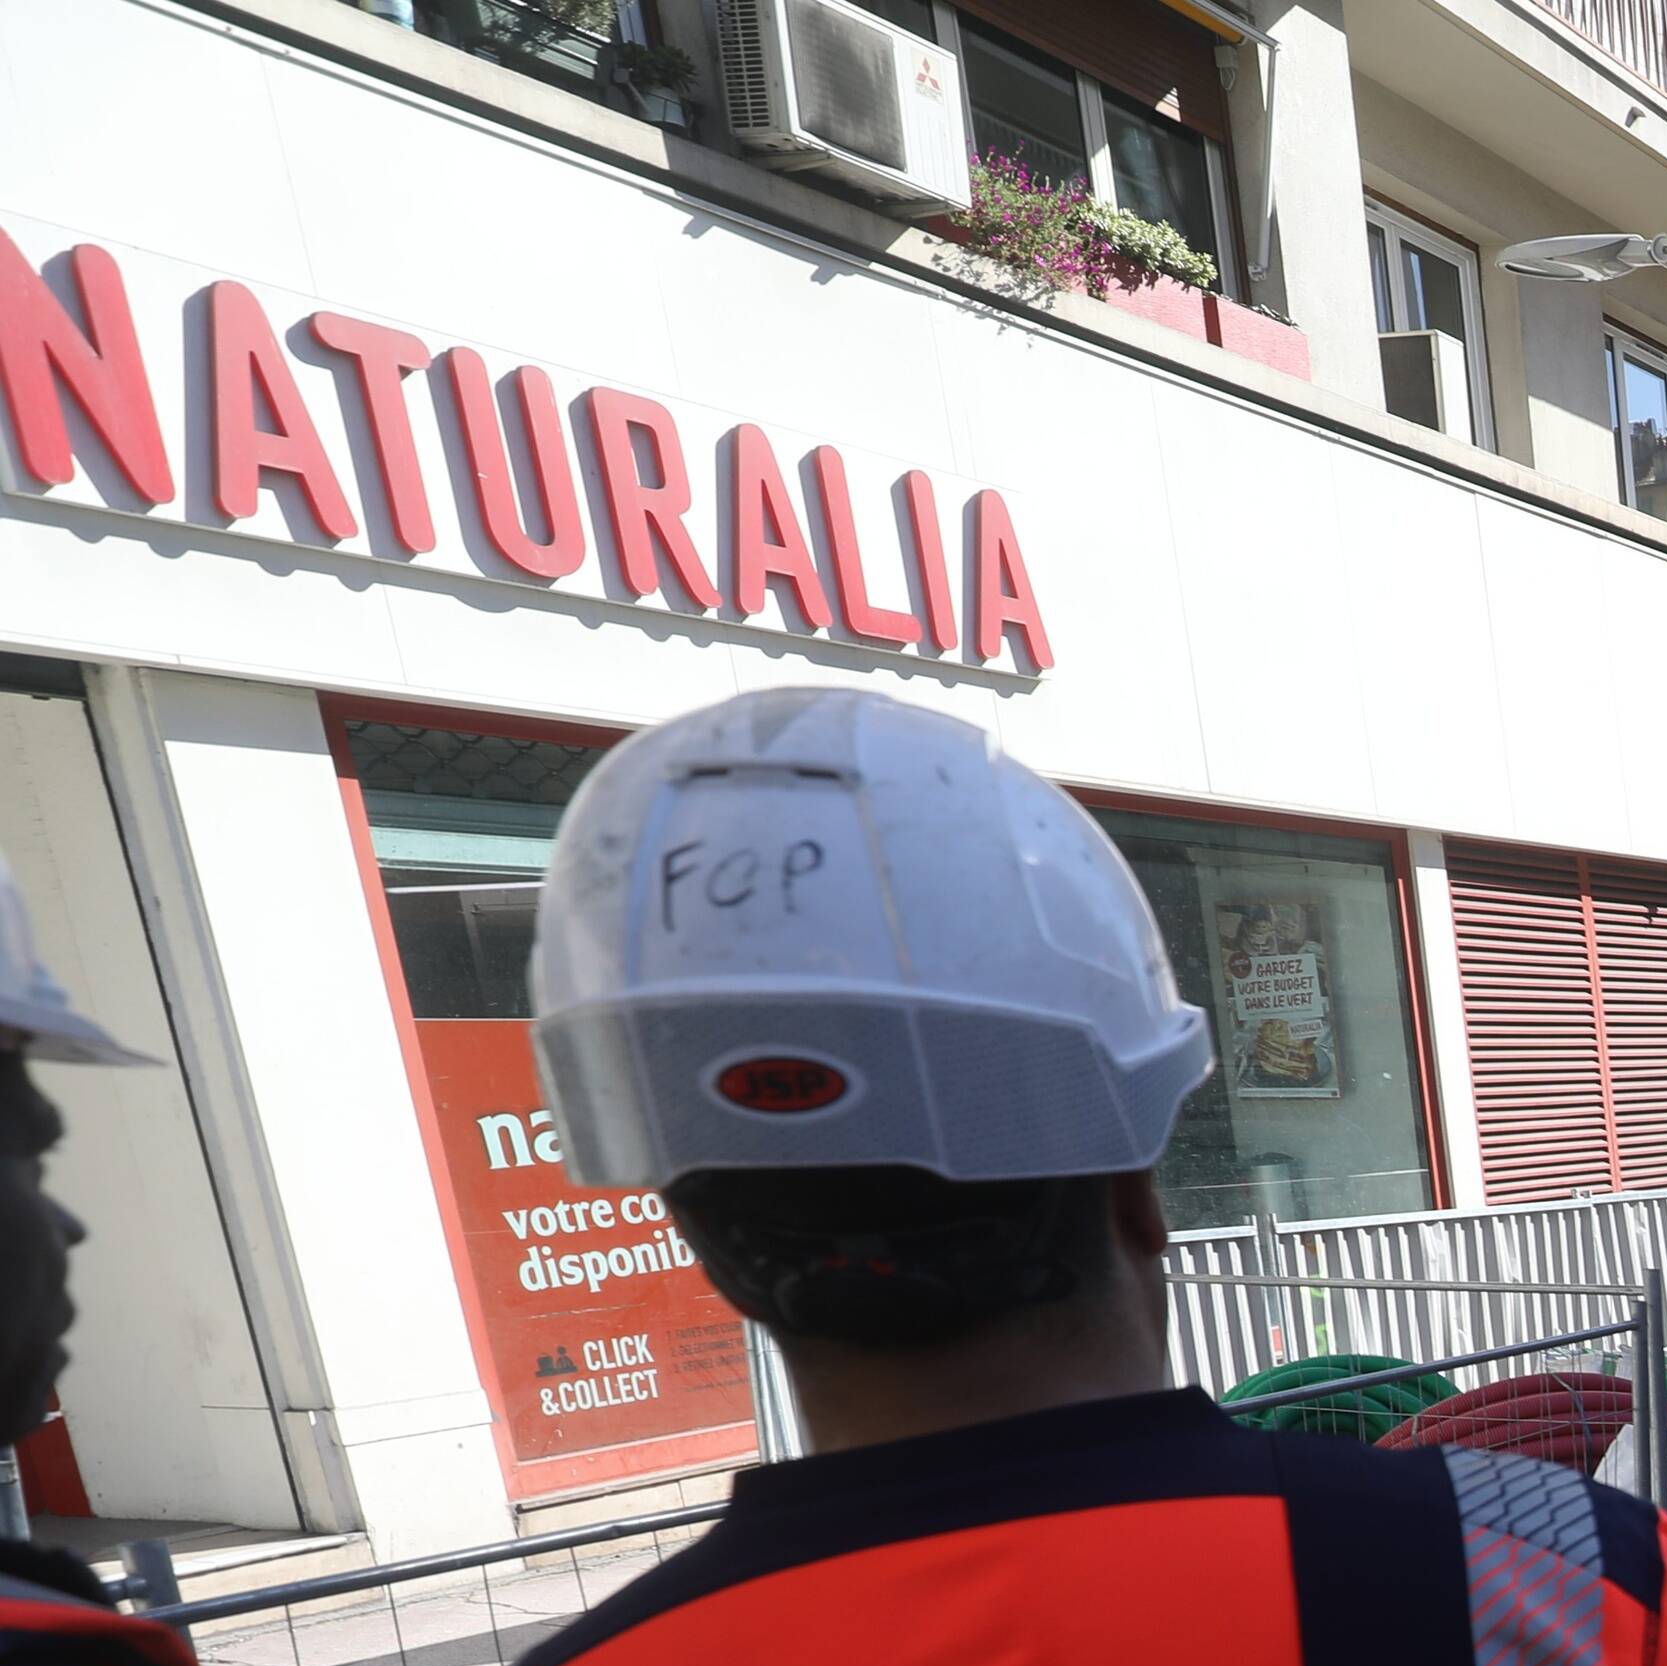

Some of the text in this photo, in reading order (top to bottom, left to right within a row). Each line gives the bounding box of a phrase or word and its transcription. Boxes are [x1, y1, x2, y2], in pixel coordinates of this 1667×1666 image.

[0, 226, 1056, 671] NATURALIA
[1256, 958, 1303, 977] GARDEZ
[1237, 976, 1314, 995] VOTRE BUDGET
[1244, 992, 1314, 1010] DANS LE VERT
[502, 1199, 616, 1240] votre
[583, 1334, 655, 1372] CLICK
